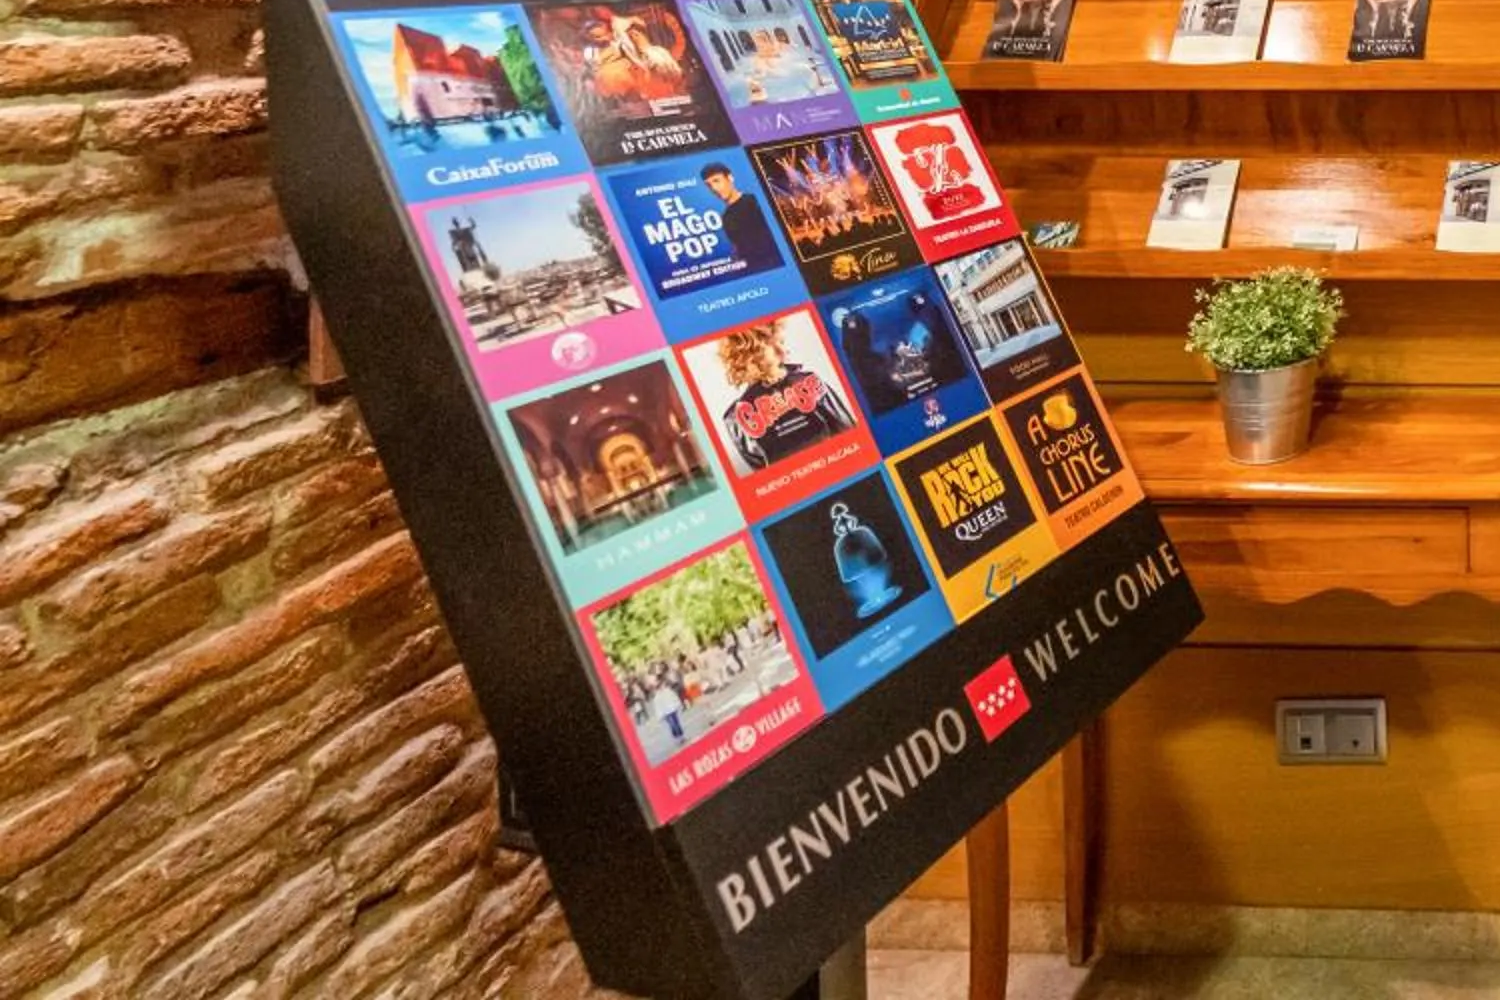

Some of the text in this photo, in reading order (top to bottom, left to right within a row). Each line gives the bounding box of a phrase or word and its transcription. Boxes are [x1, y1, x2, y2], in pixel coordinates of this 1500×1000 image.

[636, 129, 708, 151] CARMELA
[426, 151, 560, 186] CaixaForum
[657, 195, 695, 219] EL
[643, 209, 723, 245] MAGO
[665, 233, 719, 263] POP
[697, 286, 769, 313] TEATRO APOLO
[1027, 414, 1048, 446] A
[1040, 422, 1095, 466] CHORUS
[920, 441, 1000, 529] ROCK
[1047, 441, 1111, 503] LINE
[971, 479, 1006, 508] YOU
[955, 501, 1007, 541] QUEEN
[1023, 541, 1181, 683] WELCOME
[669, 695, 801, 796] LAS ROZAS VILLAGE
[716, 707, 967, 934] BIENVENIDO
